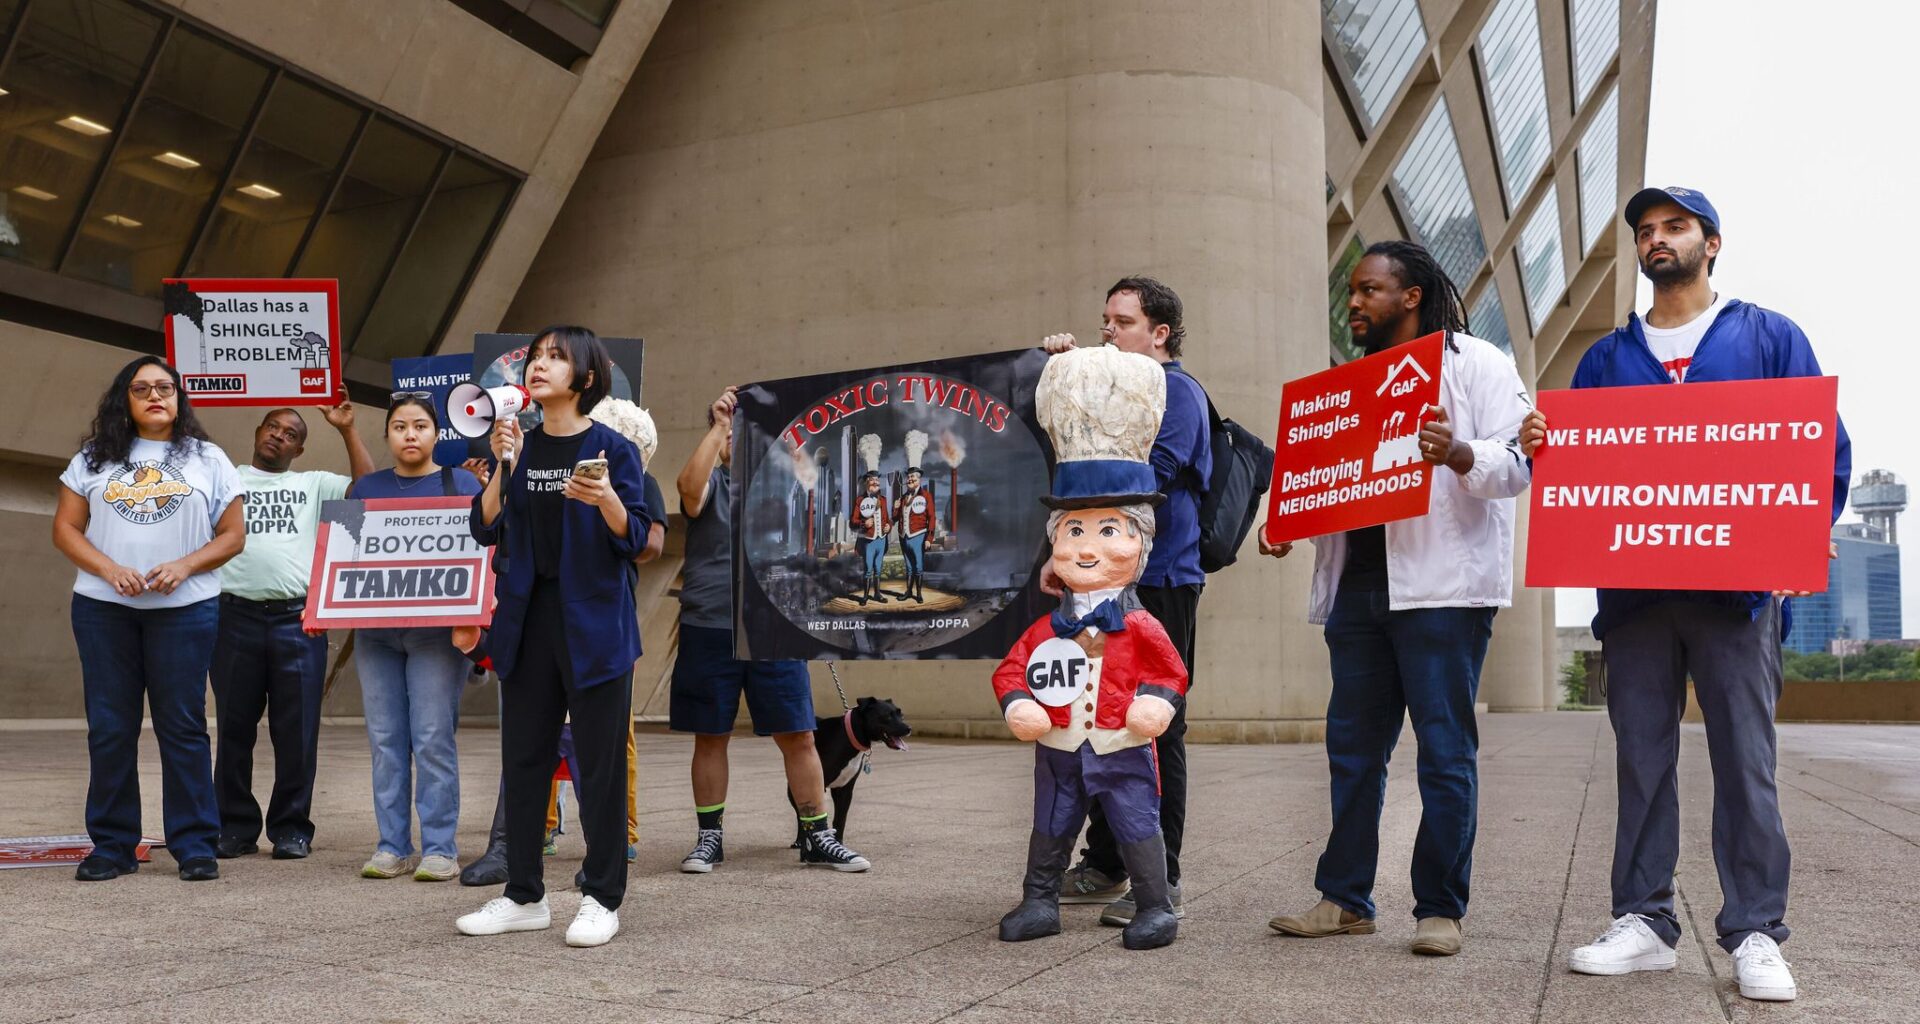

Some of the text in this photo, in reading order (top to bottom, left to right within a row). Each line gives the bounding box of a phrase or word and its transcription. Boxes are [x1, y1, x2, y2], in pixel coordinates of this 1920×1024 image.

[203, 298, 309, 313] Dallas has a
[210, 323, 303, 337] SHINGLES
[213, 347, 302, 362] PROBLEM
[187, 377, 242, 391] TAMKO
[301, 377, 325, 387] GAF
[398, 373, 471, 389] WE HAVE THE
[1391, 376, 1420, 398] GAF
[1290, 389, 1351, 419] Making
[783, 375, 1012, 451] TOXIC TWINS
[1287, 413, 1360, 445] Shingles
[1547, 421, 1823, 446] WE HAVE THE RIGHT TO
[527, 468, 571, 480] RONMENTAL
[1281, 458, 1363, 493] Destroying
[103, 480, 193, 503] Singleton
[527, 481, 535, 491] IS
[537, 482, 543, 492] A
[1278, 469, 1423, 516] NEIGHBORHOODS
[244, 489, 307, 505] USTICIA
[1542, 483, 1819, 507] ENVIRONMENTAL
[247, 504, 295, 519] PARA
[384, 515, 470, 527] PROTECT JOP
[1609, 523, 1731, 551] JUSTICE
[339, 567, 469, 599] TAMKO
[807, 620, 866, 631] WEST DALLAS
[929, 618, 969, 629] JOPPA
[1027, 658, 1086, 690] GAF
